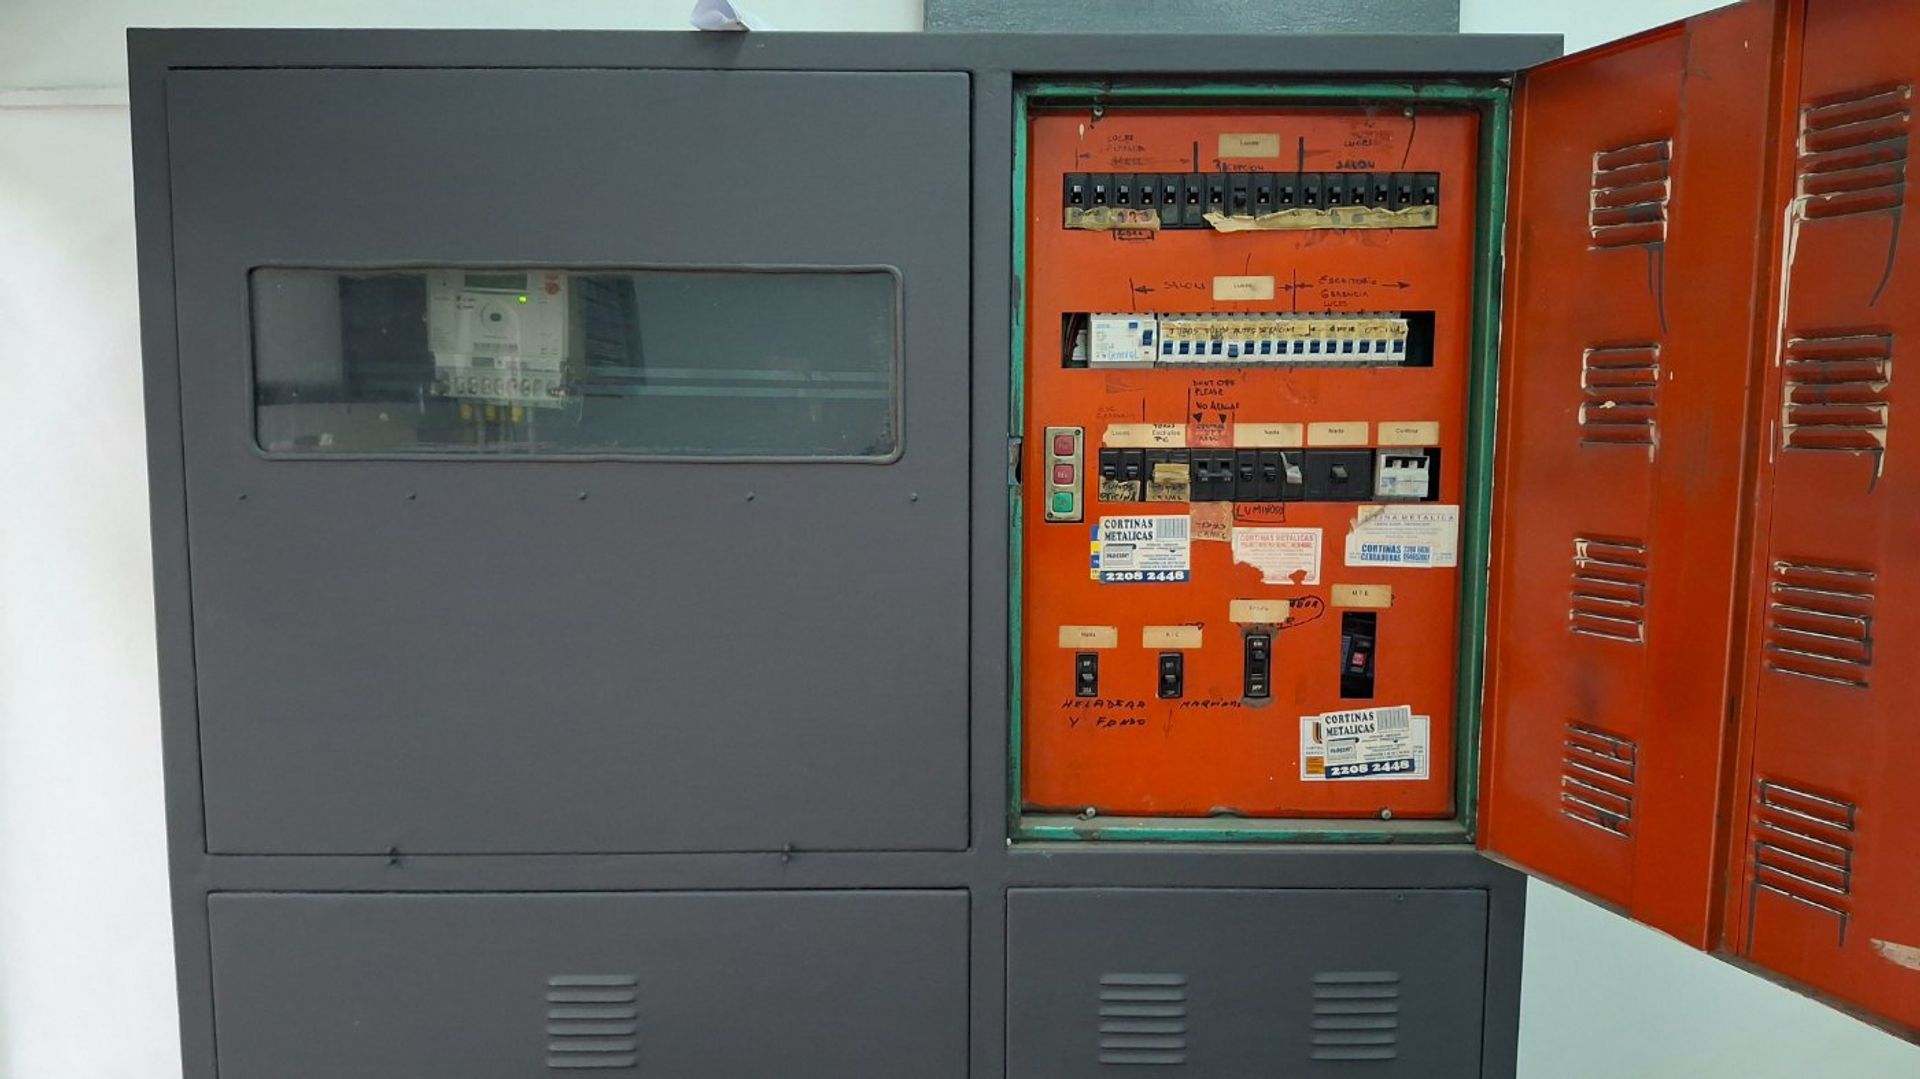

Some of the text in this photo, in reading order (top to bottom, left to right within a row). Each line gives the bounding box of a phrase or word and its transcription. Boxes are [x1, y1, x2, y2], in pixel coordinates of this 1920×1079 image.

[1336, 160, 1375, 170] SALON
[1104, 519, 1154, 529] CORTINAS
[1104, 531, 1154, 541] METALICAS
[1361, 544, 1402, 553] CORTINAS
[1106, 570, 1185, 581] 2208 2448
[1069, 716, 1146, 728] Y FONDO
[1324, 711, 1375, 725] CORTINAS
[1326, 723, 1376, 737] METALICAS
[1330, 760, 1410, 777] 2208 2448
